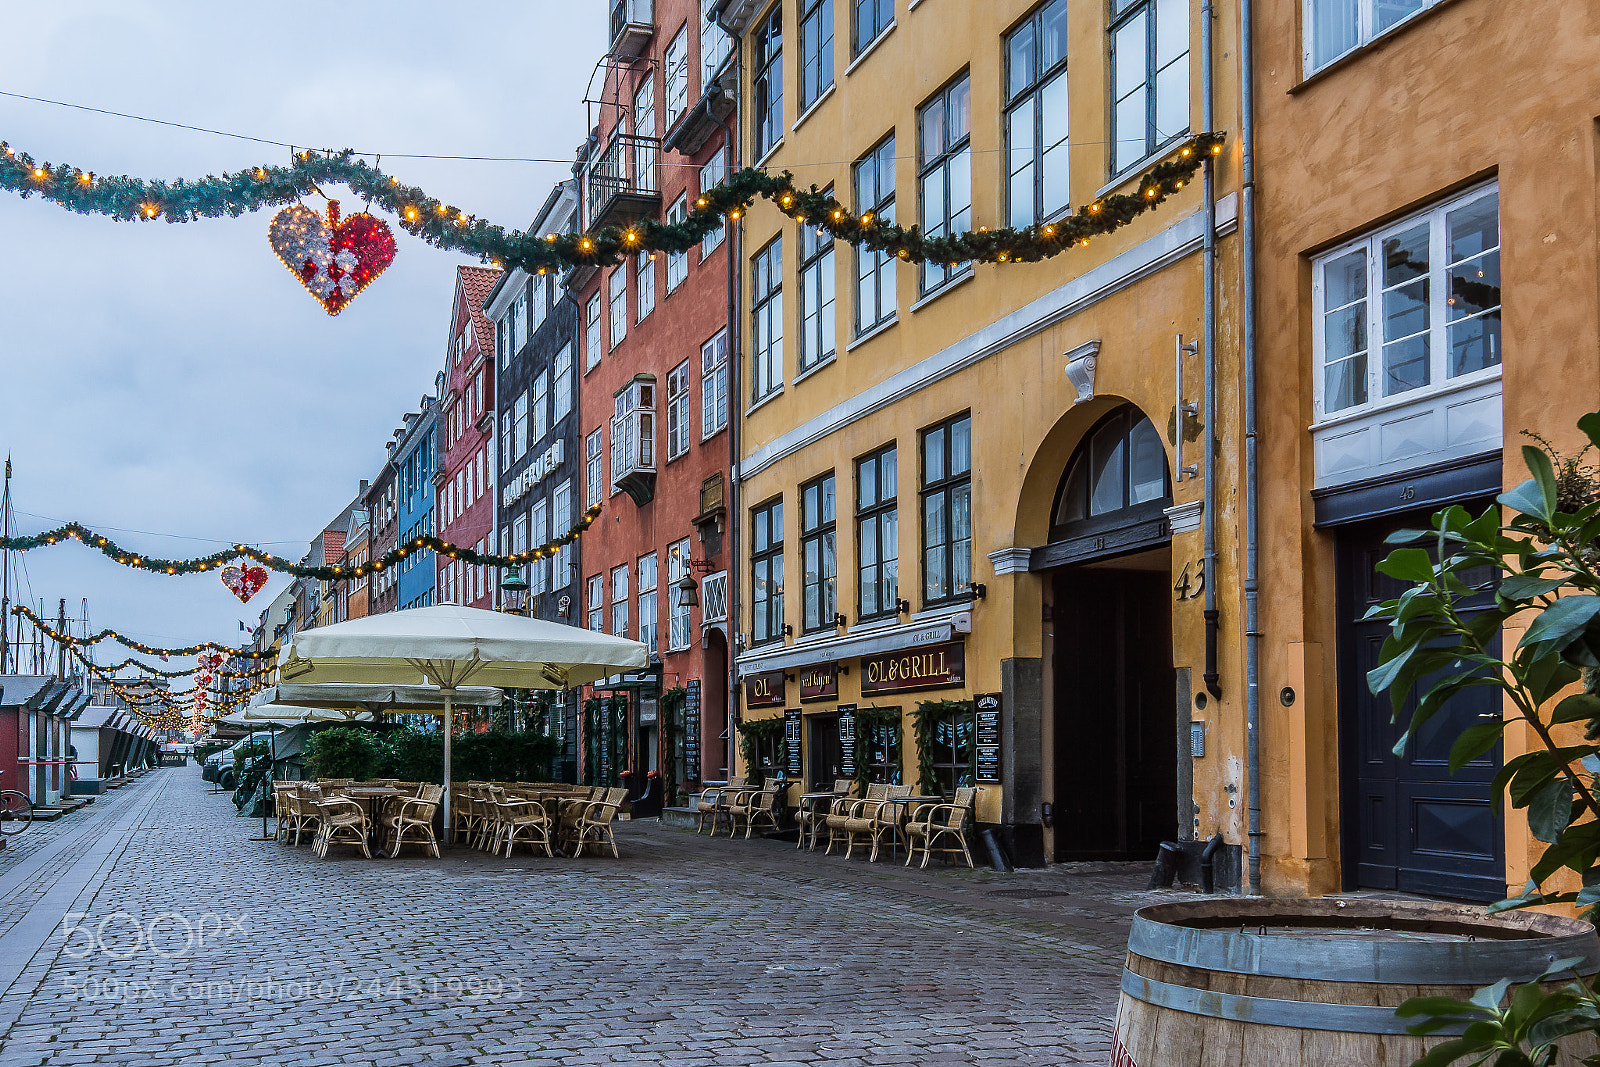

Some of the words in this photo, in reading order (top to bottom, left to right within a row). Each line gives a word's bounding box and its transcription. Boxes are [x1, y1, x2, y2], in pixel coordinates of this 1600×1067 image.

[503, 439, 564, 508] HAVFRUEN
[1399, 486, 1415, 500] 45
[1173, 558, 1205, 601] 43
[754, 678, 771, 697] ØL
